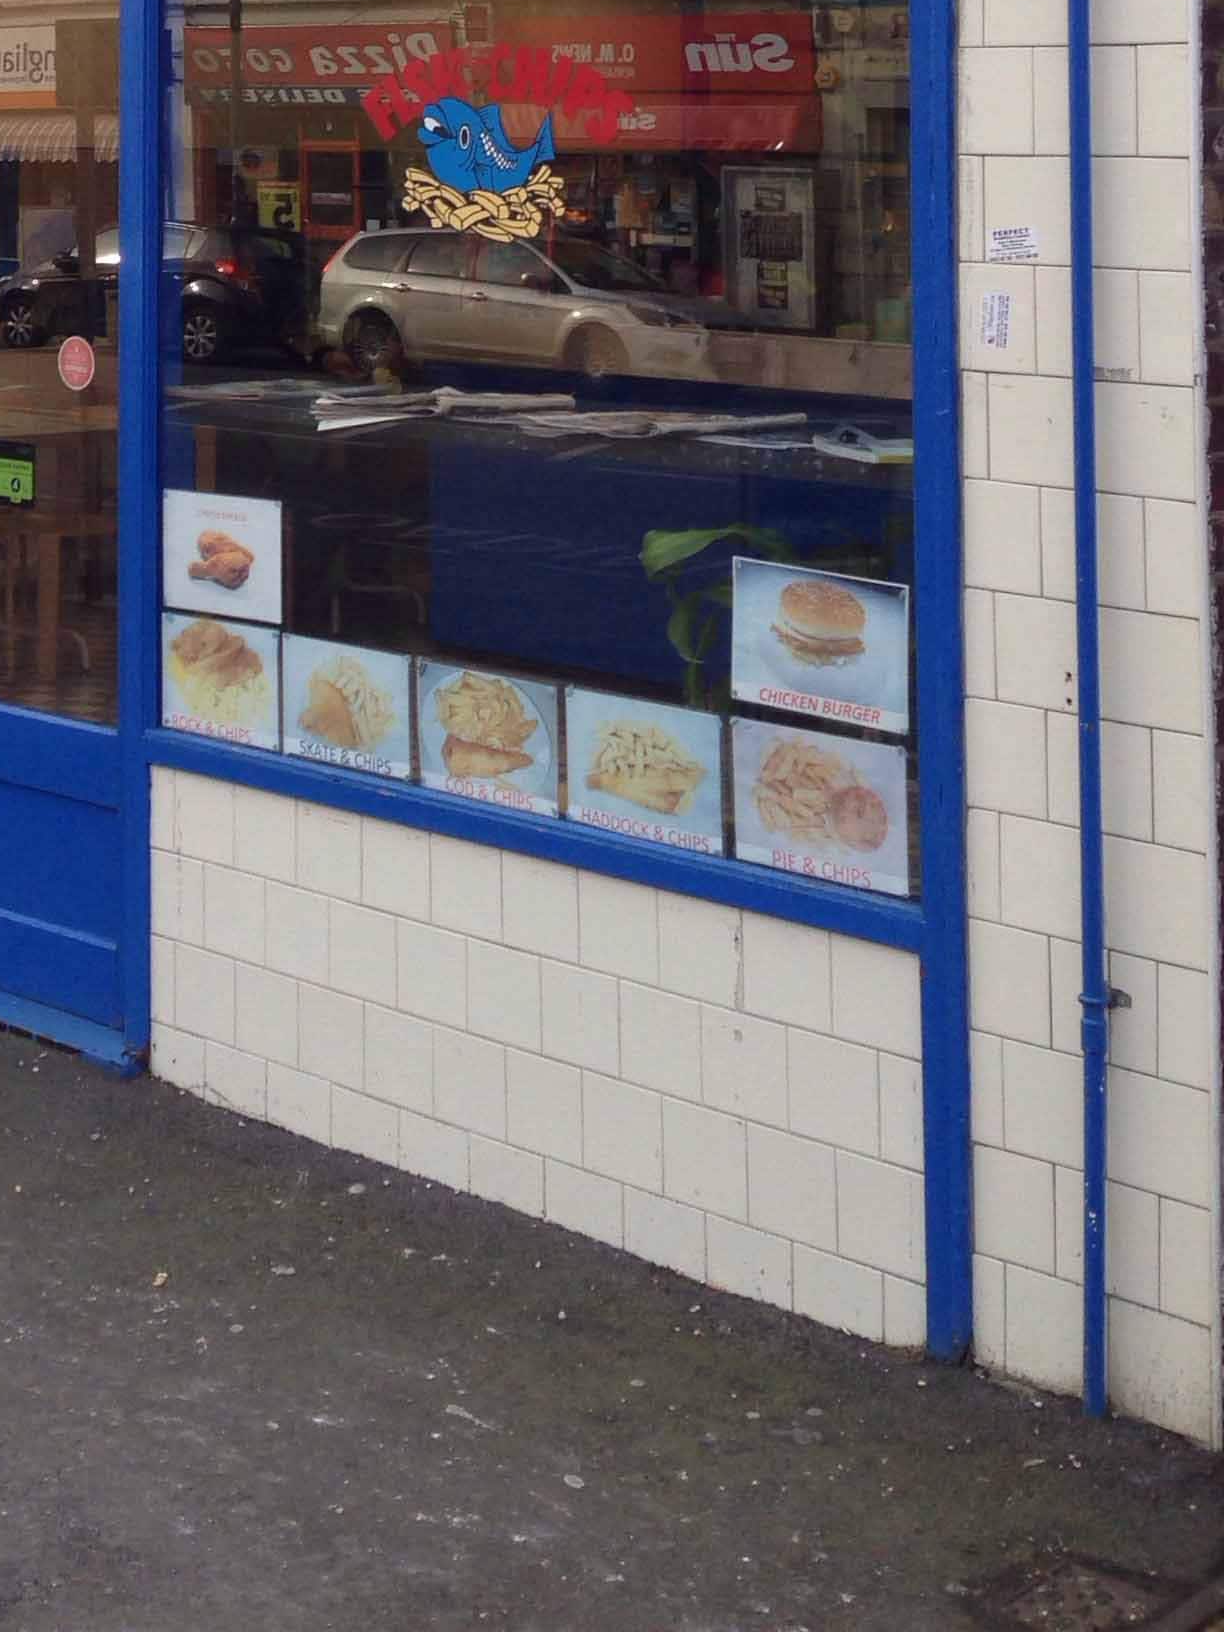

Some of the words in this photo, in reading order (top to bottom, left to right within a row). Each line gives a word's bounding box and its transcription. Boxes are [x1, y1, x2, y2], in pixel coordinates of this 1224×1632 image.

[361, 46, 471, 141] FISH
[488, 43, 635, 146] CHIPS
[759, 687, 820, 712] CHICKEN
[821, 699, 882, 724] BURGER
[217, 724, 250, 743] CHIPS
[298, 739, 337, 762] SKATE
[340, 748, 351, 764] &
[354, 751, 392, 775] CHIPS
[445, 776, 474, 796] COD
[477, 785, 489, 799] &
[492, 788, 534, 811] CHIPS
[581, 808, 651, 839] HADDOCK
[654, 825, 665, 841] &
[668, 829, 710, 853] CHIPS
[772, 849, 796, 870] PIE
[802, 856, 816, 876] &
[821, 862, 872, 889] CHIPS
